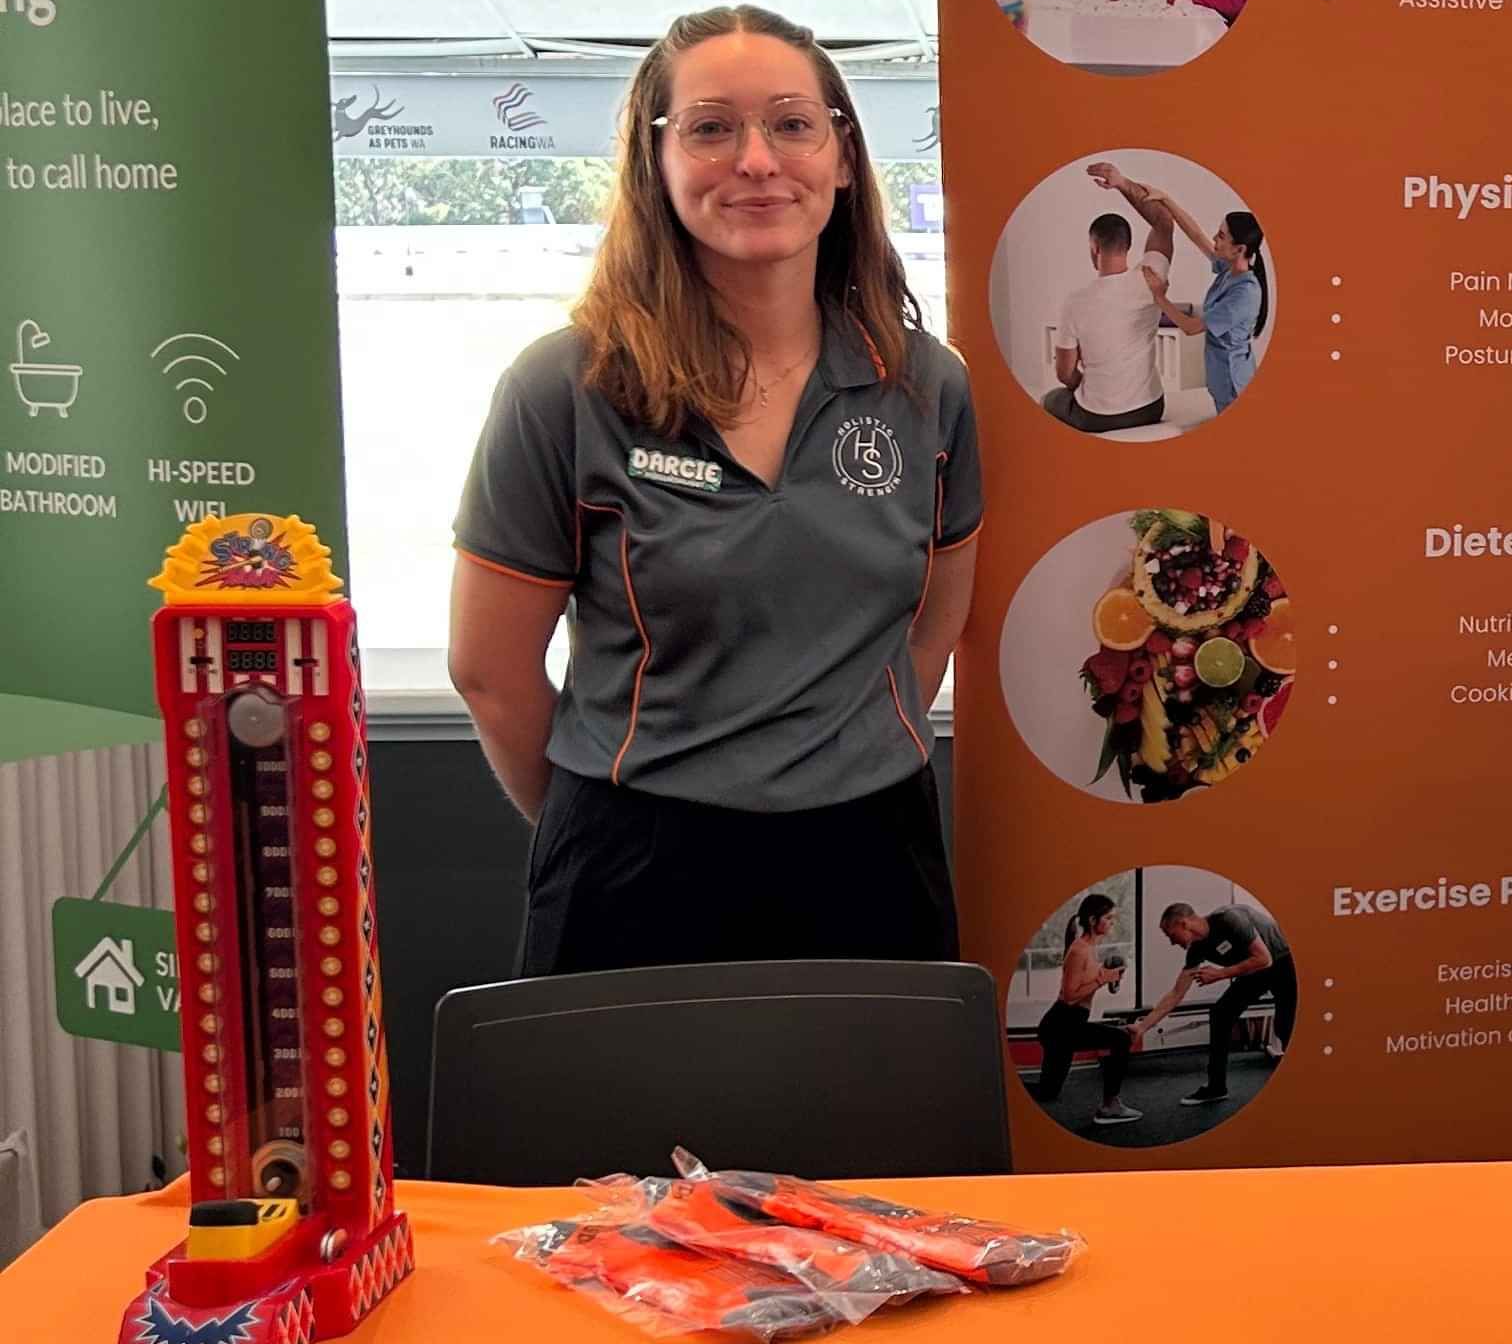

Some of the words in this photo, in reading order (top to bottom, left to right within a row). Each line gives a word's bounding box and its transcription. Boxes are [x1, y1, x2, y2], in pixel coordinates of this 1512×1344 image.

[0, 92, 57, 128] lace
[62, 94, 92, 126] to
[101, 90, 160, 131] live,
[367, 125, 434, 136] GREYHOUNDS
[368, 138, 382, 149] AS
[384, 138, 409, 149] PETS
[7, 157, 36, 189] to
[43, 154, 88, 189] call
[94, 153, 178, 190] home
[1450, 271, 1500, 292] Pain
[7, 452, 106, 479] MODIFIED
[148, 459, 256, 486] HI-SPEED
[630, 447, 722, 484] DARCIE
[0, 489, 118, 519] BATHROOM
[174, 499, 229, 522] WIFI
[1333, 877, 1492, 917] Exercise
[1386, 1026, 1501, 1054] Motivation
